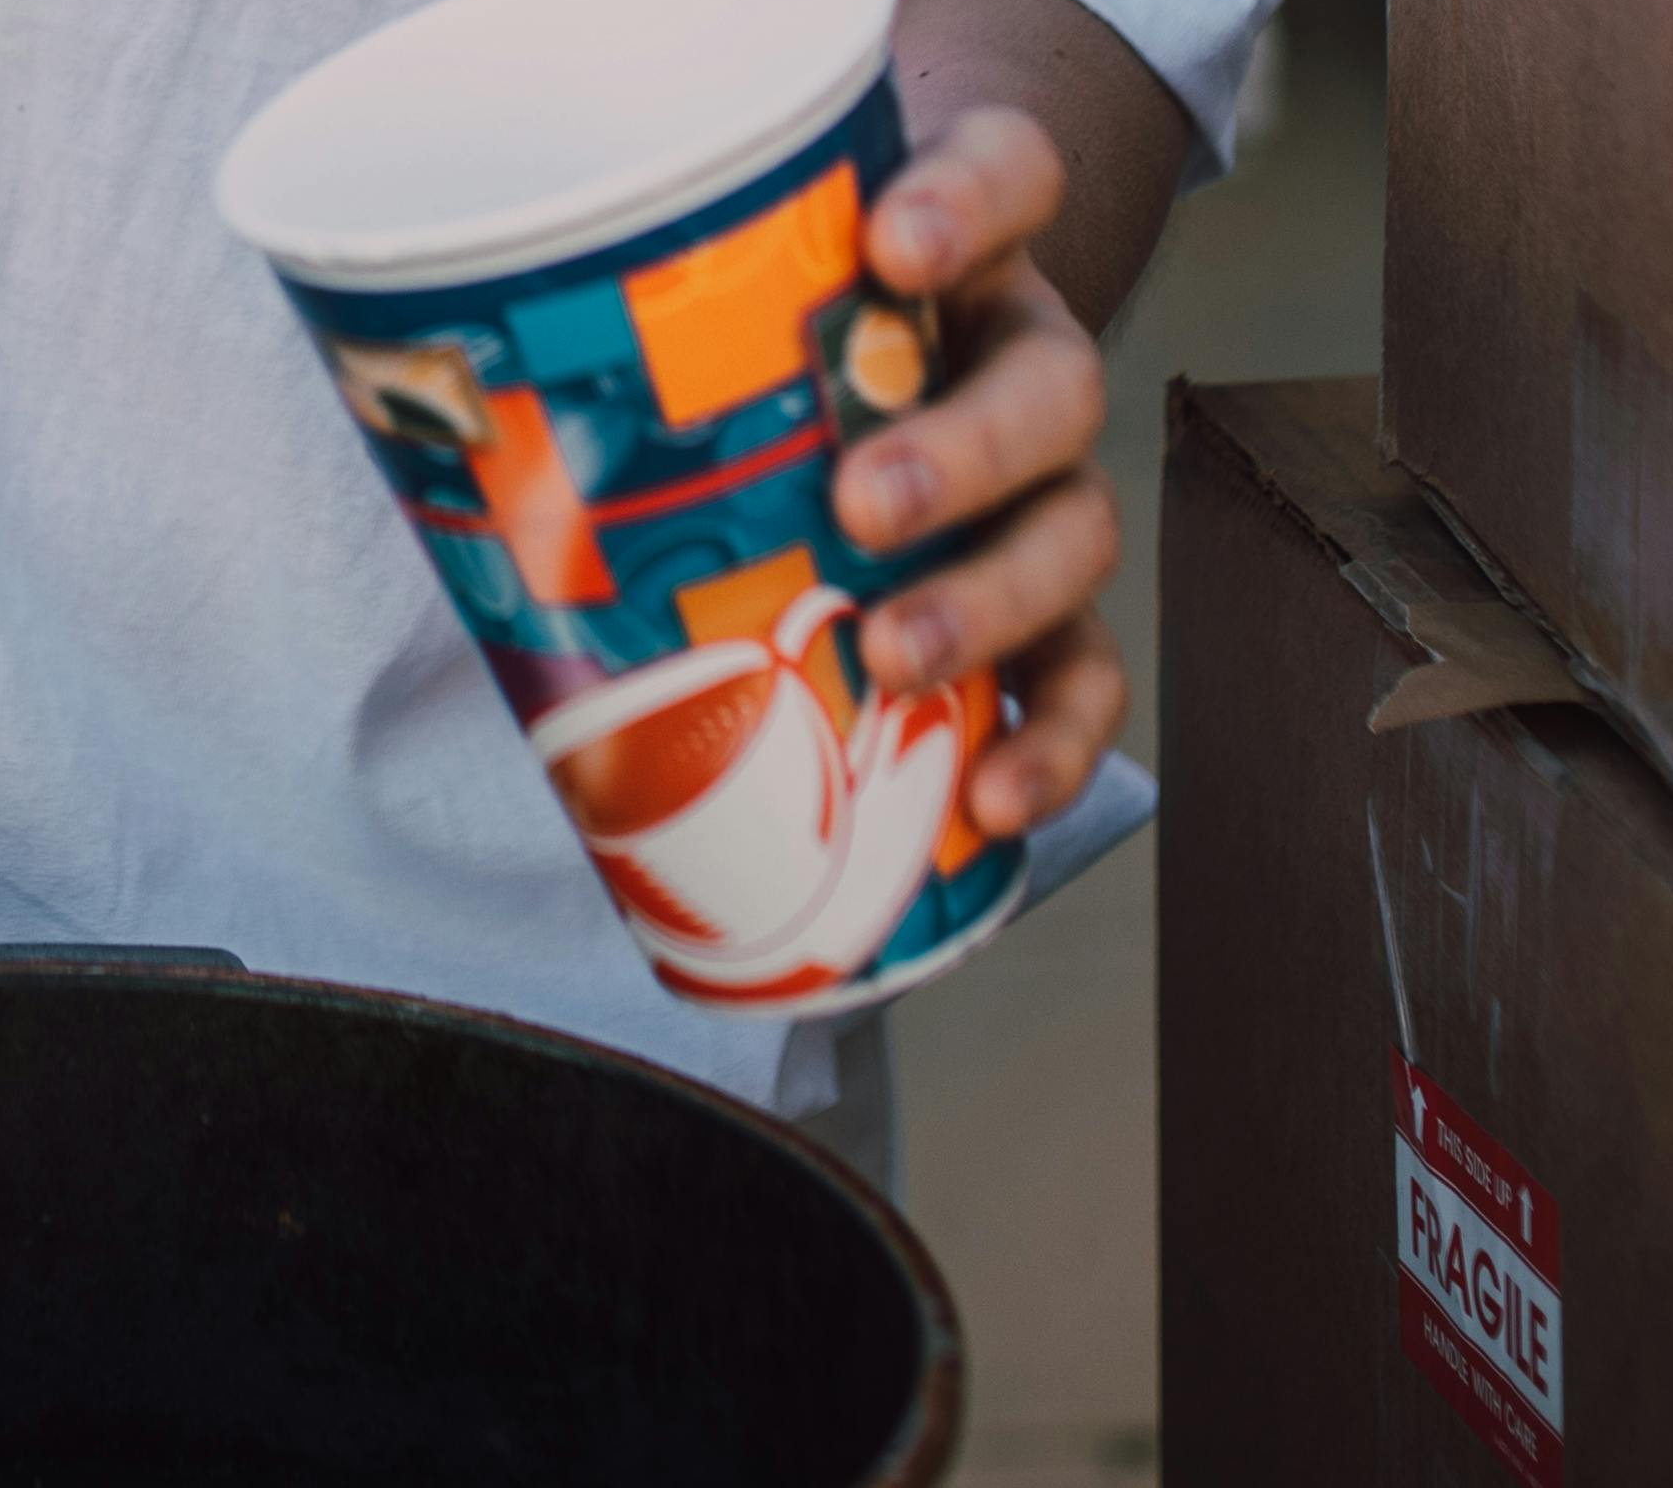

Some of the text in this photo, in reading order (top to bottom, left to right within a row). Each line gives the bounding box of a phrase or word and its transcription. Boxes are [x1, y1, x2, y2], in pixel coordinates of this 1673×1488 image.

[1435, 1115, 1514, 1212] THIS SIDE UP
[1409, 1174, 1549, 1399] FRAGILE
[1422, 1311, 1470, 1387] HANDLE
[1470, 1364, 1503, 1423] WITH
[1503, 1401, 1539, 1463] CARE
